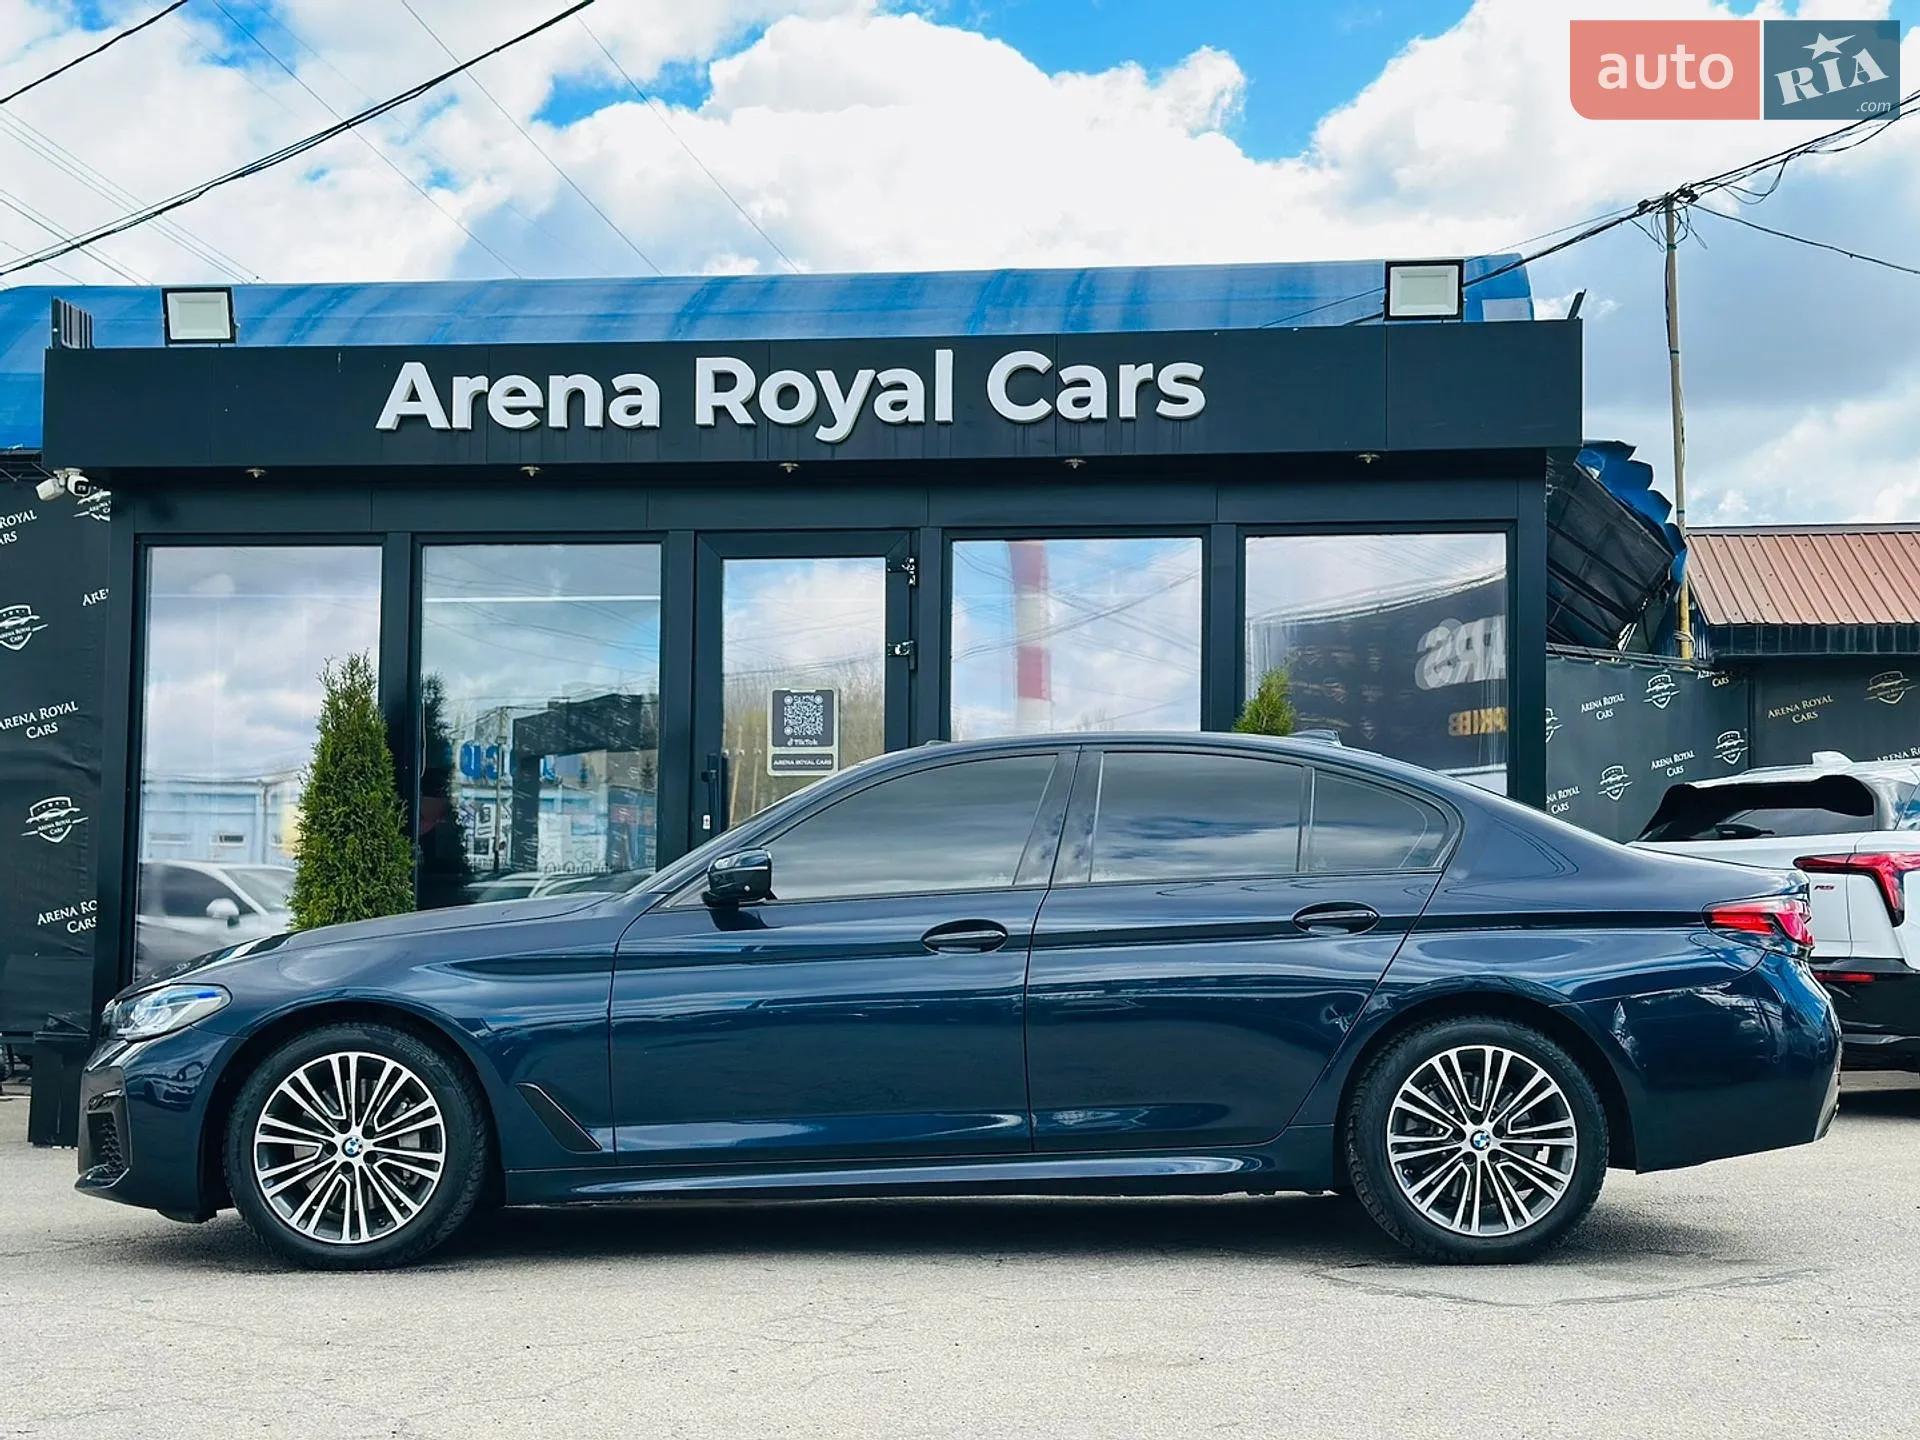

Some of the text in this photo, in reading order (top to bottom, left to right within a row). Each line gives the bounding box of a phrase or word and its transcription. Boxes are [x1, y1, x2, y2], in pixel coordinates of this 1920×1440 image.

[375, 350, 1206, 443] Arena Royal Cars
[82, 588, 109, 607] ARE
[39, 700, 79, 721] ROYAL
[1580, 693, 1625, 713] ARENA ROYAL
[1767, 694, 1834, 719] ARENA ROYAL
[1595, 708, 1614, 721] CARS
[1792, 710, 1819, 724] CARS
[26, 721, 59, 739] CARS
[1650, 750, 1696, 771] ARENA ROYAL
[1666, 765, 1685, 778] CARS
[1557, 785, 1580, 799] ROYAL
[1551, 801, 1570, 815] CARS
[37, 906, 79, 926] ARENA
